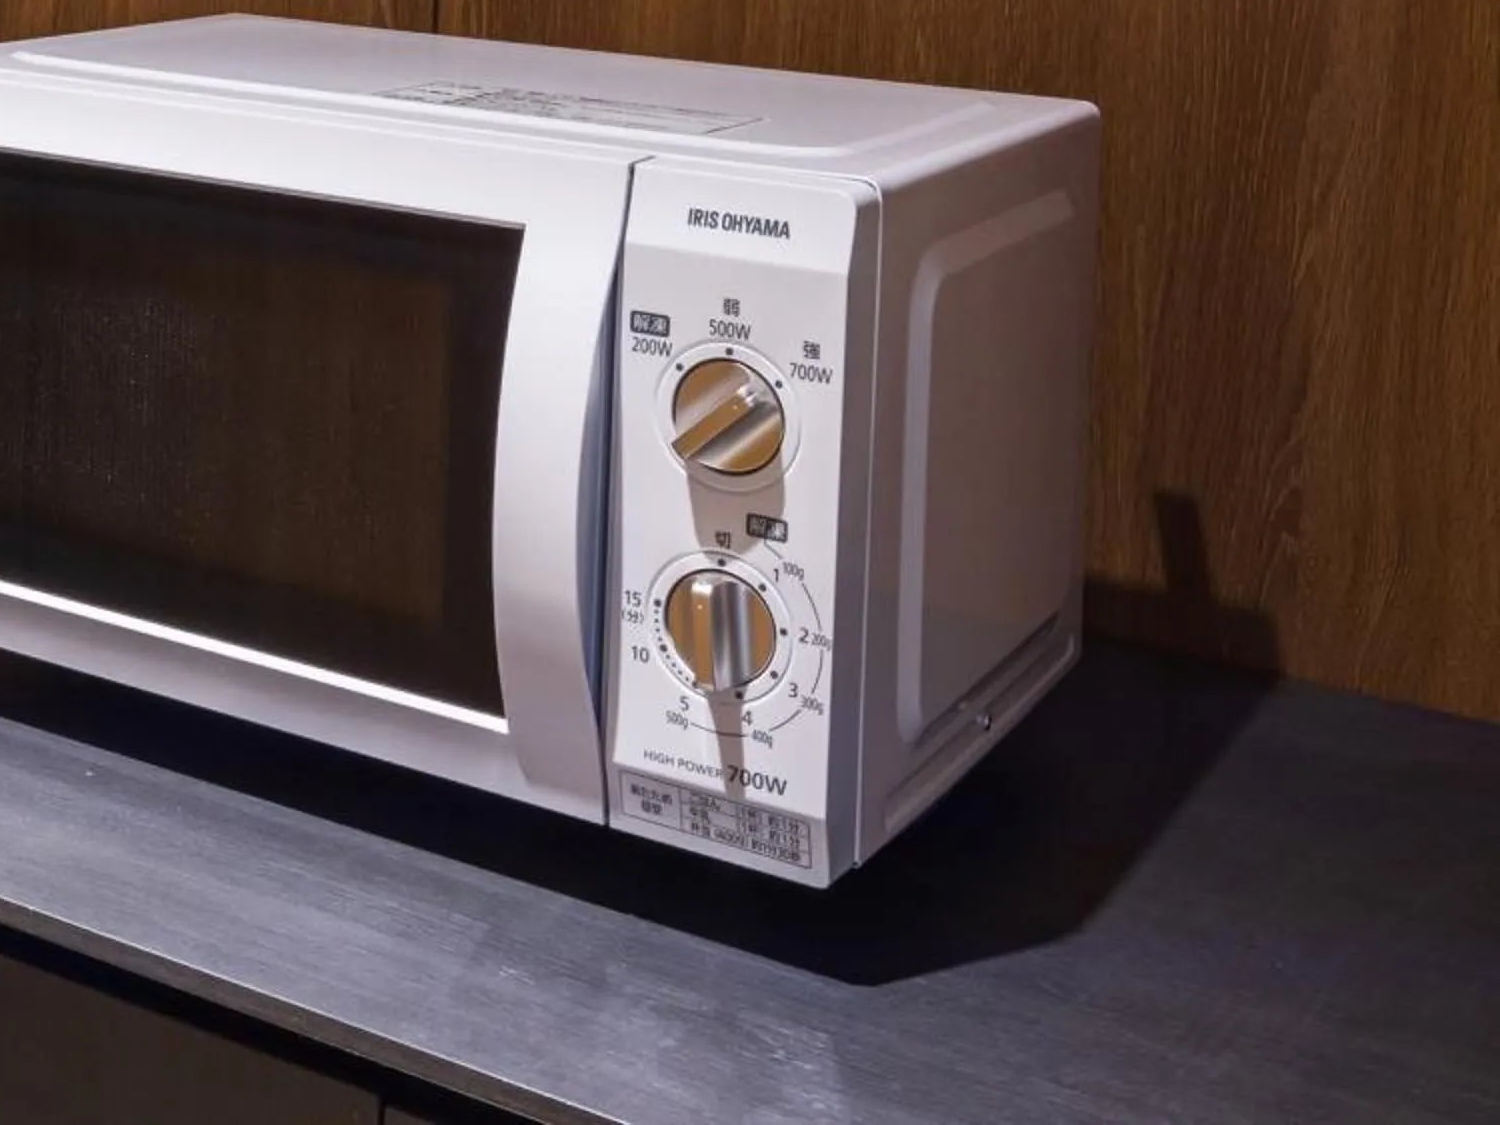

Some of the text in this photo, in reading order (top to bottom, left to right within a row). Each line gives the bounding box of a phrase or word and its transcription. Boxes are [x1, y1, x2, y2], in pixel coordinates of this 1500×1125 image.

[687, 208, 791, 240] IRIS OHYAMA
[708, 319, 752, 340] 500W
[631, 337, 673, 358] 200W
[802, 340, 821, 360] 強
[789, 362, 834, 385] 700W
[773, 568, 780, 582] 1
[624, 591, 642, 607] 15
[798, 627, 810, 644] 2
[811, 632, 833, 652] 200g
[632, 647, 650, 664] 10
[788, 683, 799, 699] 3
[680, 696, 690, 711] 5
[800, 695, 825, 716] 300g
[665, 712, 689, 731] 500g
[742, 709, 753, 725] 4
[643, 750, 788, 796] HIGH POWER 700W
